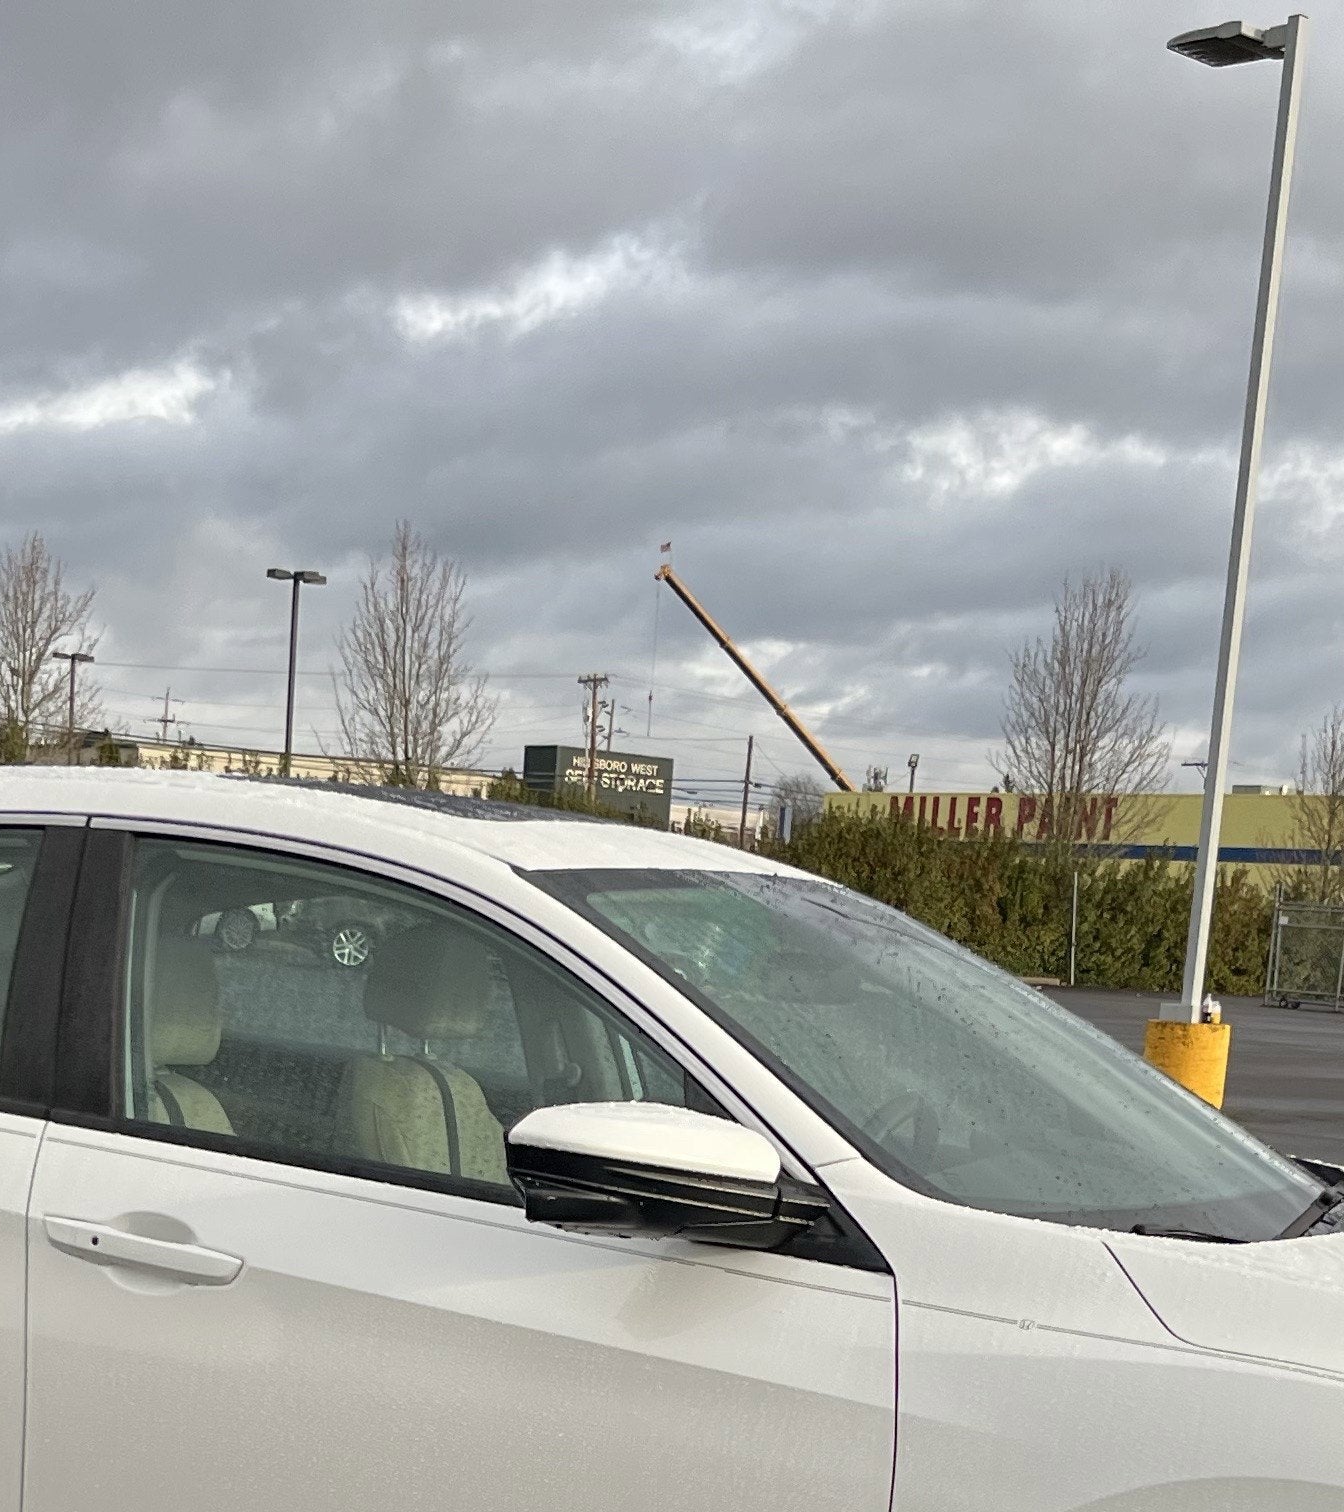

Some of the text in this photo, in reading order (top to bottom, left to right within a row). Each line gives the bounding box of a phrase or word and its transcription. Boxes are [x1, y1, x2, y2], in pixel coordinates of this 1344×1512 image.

[572, 756, 658, 776] HISBORO WEST
[888, 795, 1003, 841] MILLER
